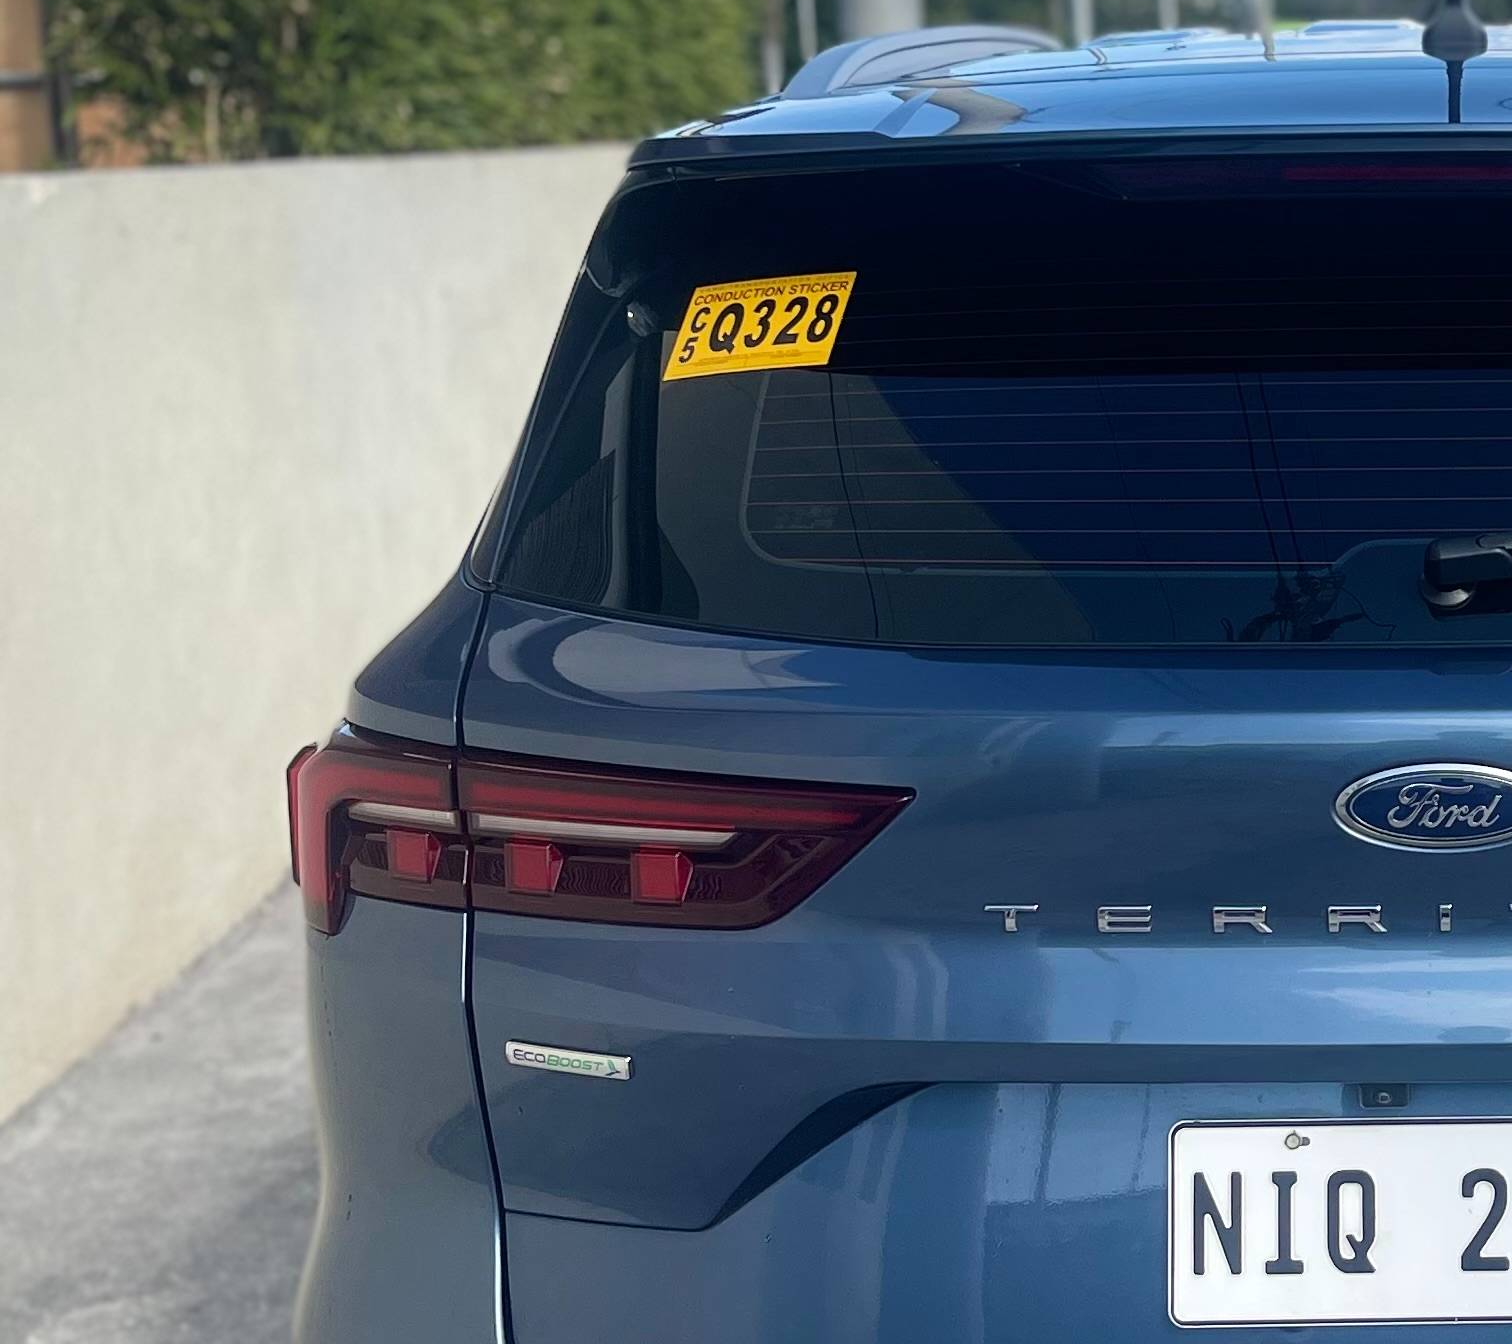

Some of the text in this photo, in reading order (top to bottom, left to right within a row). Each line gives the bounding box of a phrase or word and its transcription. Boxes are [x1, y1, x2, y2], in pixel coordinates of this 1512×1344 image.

[694, 286, 785, 306] CONDUCTION
[788, 280, 850, 295] STICKER
[708, 293, 840, 354] Q328
[1386, 782, 1503, 828] Ford
[513, 1049, 604, 1072] ECOBOOST
[1192, 1169, 1377, 1275] NIQ
